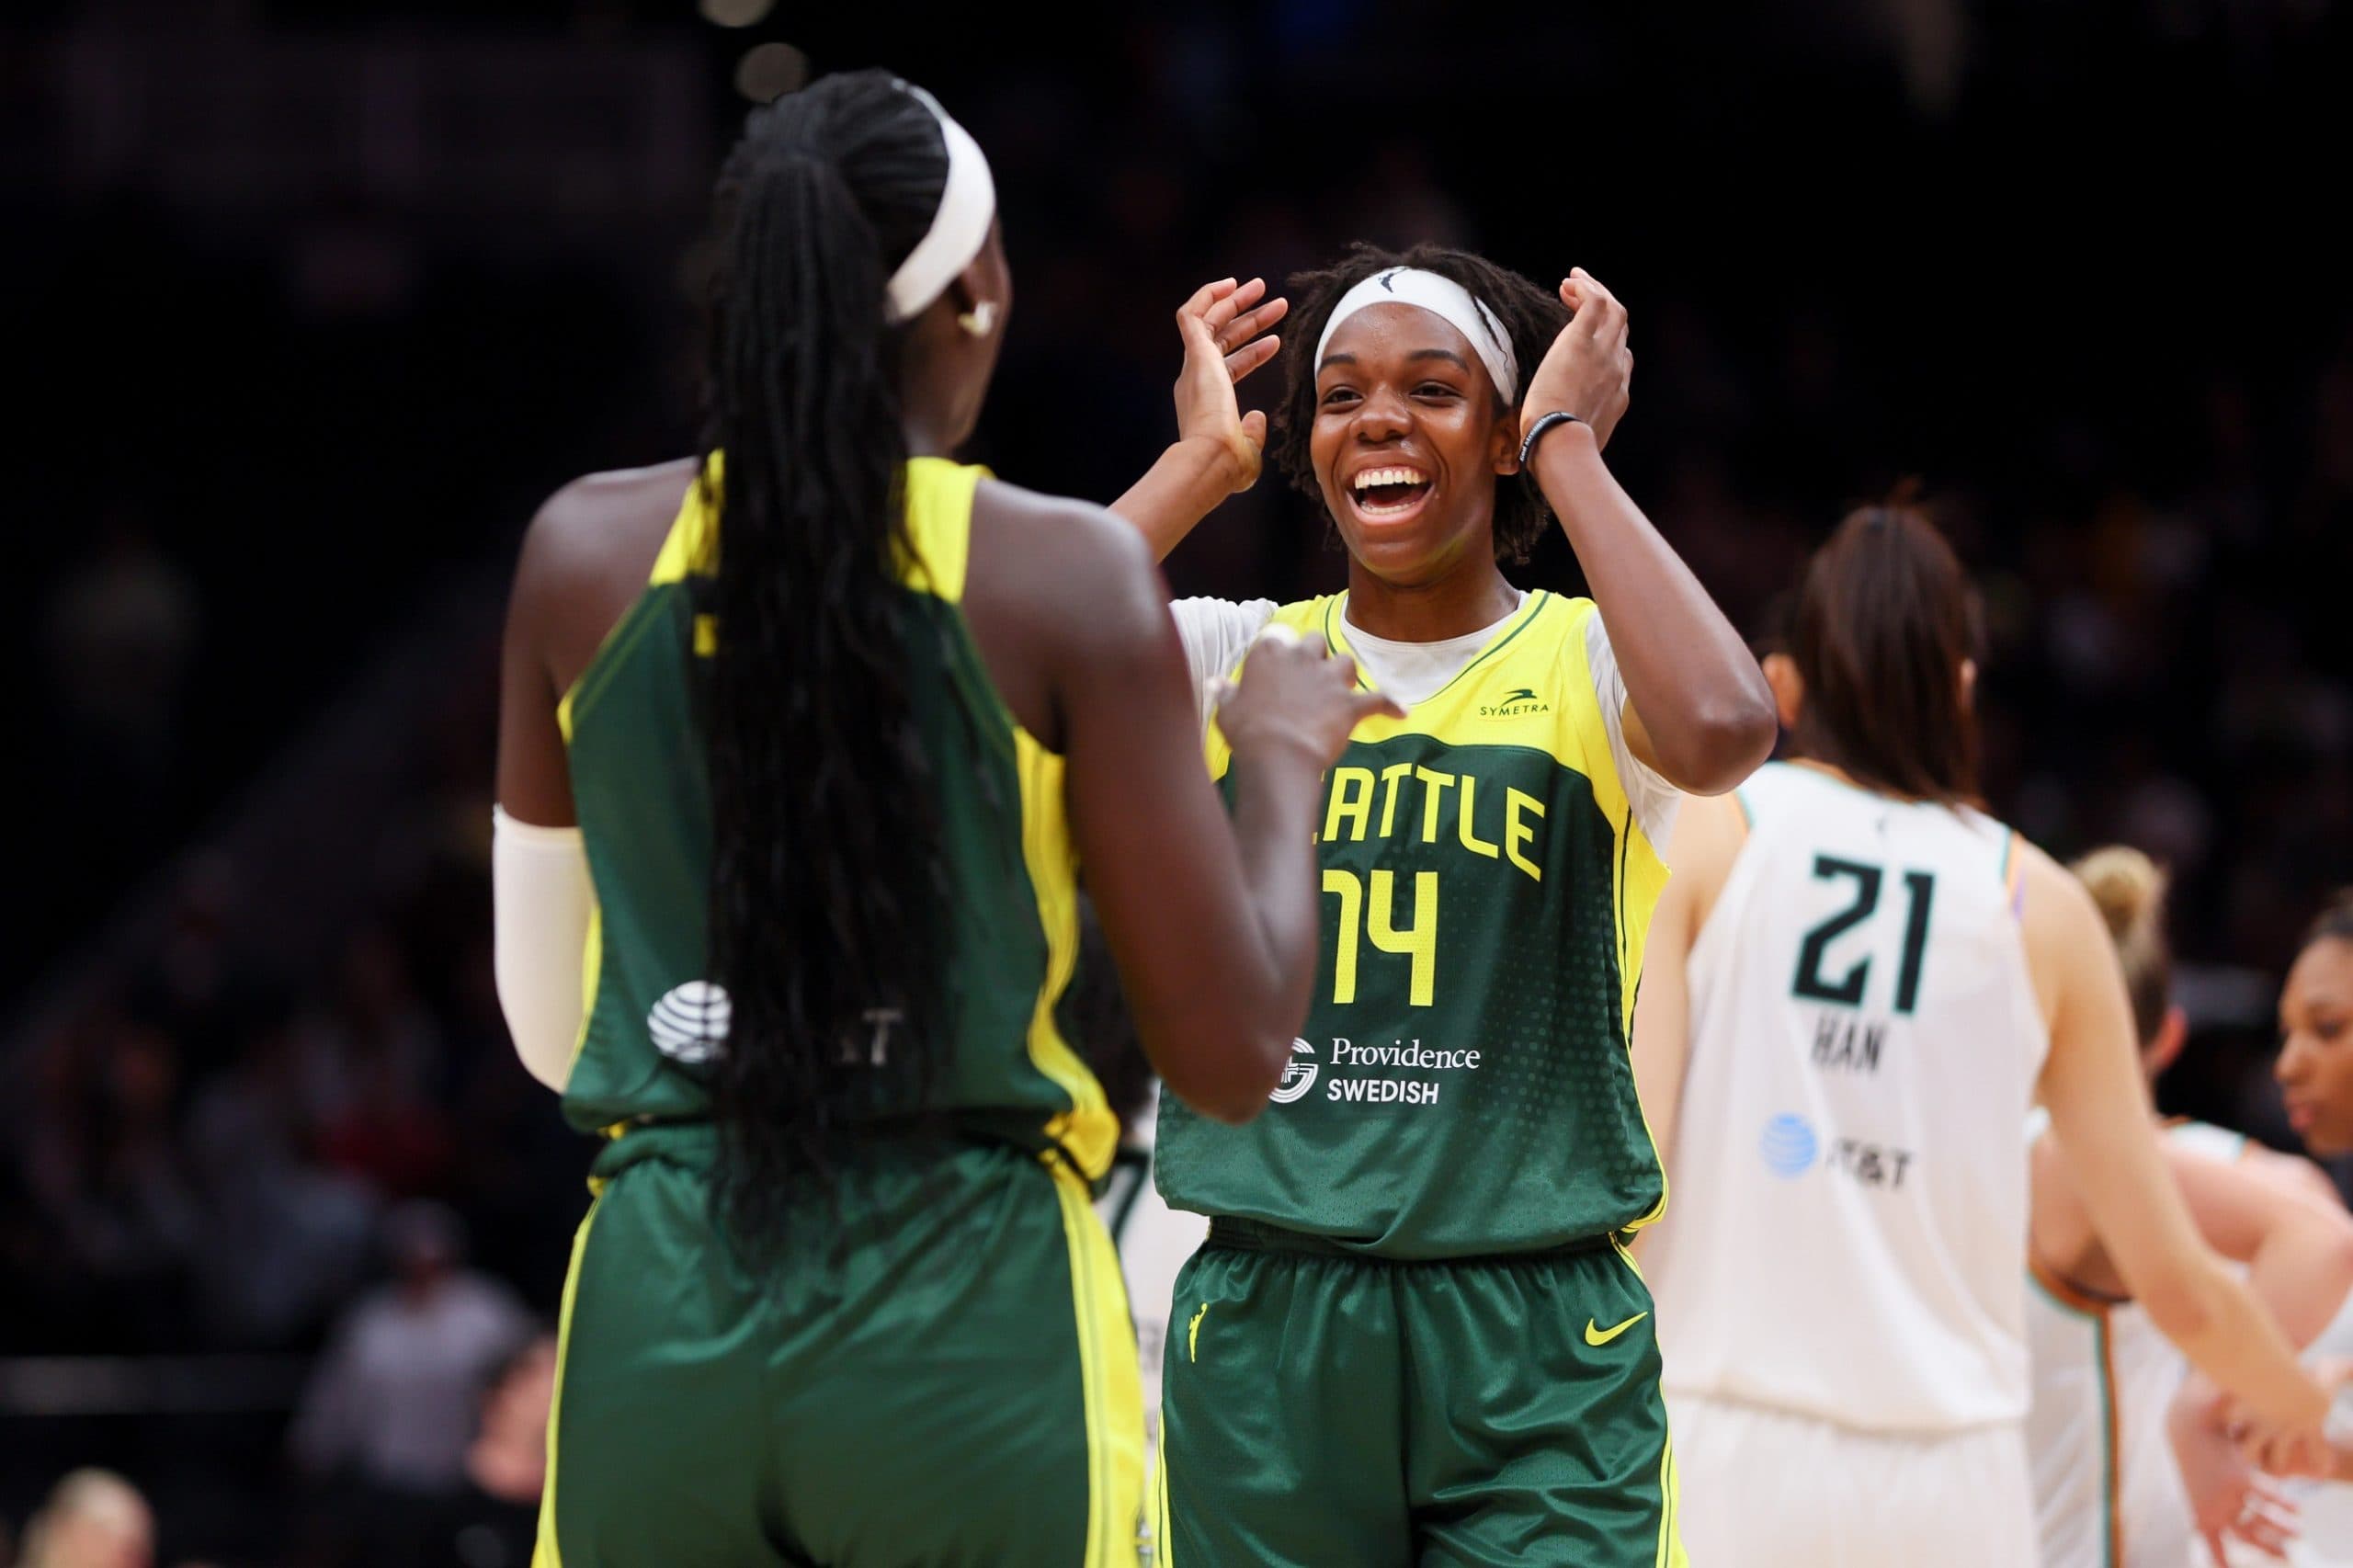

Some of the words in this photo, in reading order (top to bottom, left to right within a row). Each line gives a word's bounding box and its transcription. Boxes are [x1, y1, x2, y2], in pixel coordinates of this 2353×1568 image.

[1480, 704, 1549, 716] SYMETRA
[1313, 762, 1546, 882] ATTLE
[1322, 869, 1438, 1006] 14
[1790, 853, 1937, 1017] 21
[1330, 1038, 1481, 1069] Providence
[1812, 1017, 1887, 1073] HAN
[1326, 1078, 1439, 1104] SWEDISH
